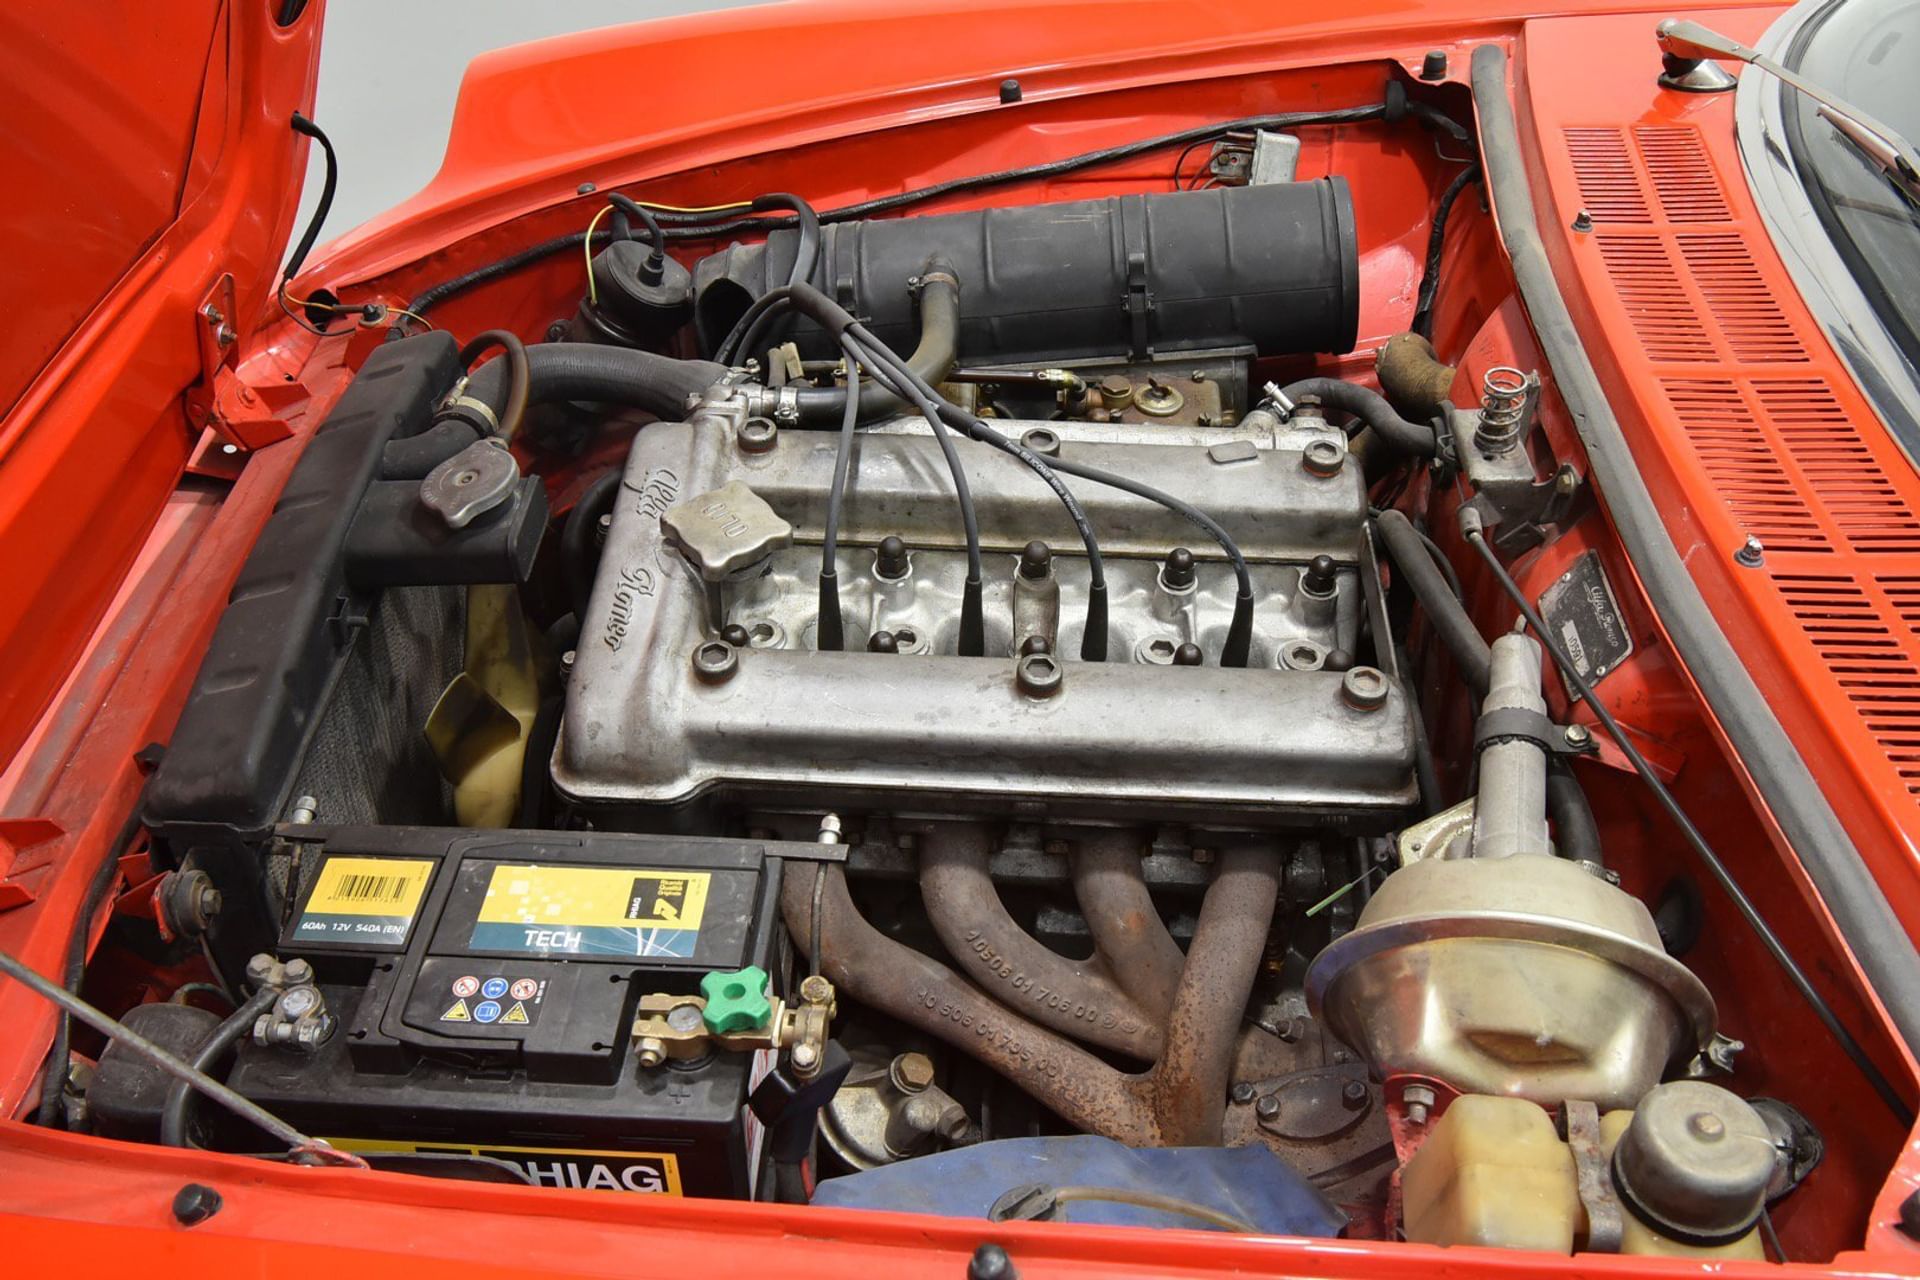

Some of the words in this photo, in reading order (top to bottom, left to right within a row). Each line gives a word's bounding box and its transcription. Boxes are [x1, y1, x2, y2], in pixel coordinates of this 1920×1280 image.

[1019, 451, 1052, 480] SILICONE
[604, 567, 656, 653] Romeo
[629, 897, 642, 919] RHIAG
[301, 921, 327, 931] 60Ah
[332, 922, 352, 932] 12V
[355, 923, 380, 933] 540A
[383, 925, 405, 935] (EN)
[524, 929, 582, 949] TECH
